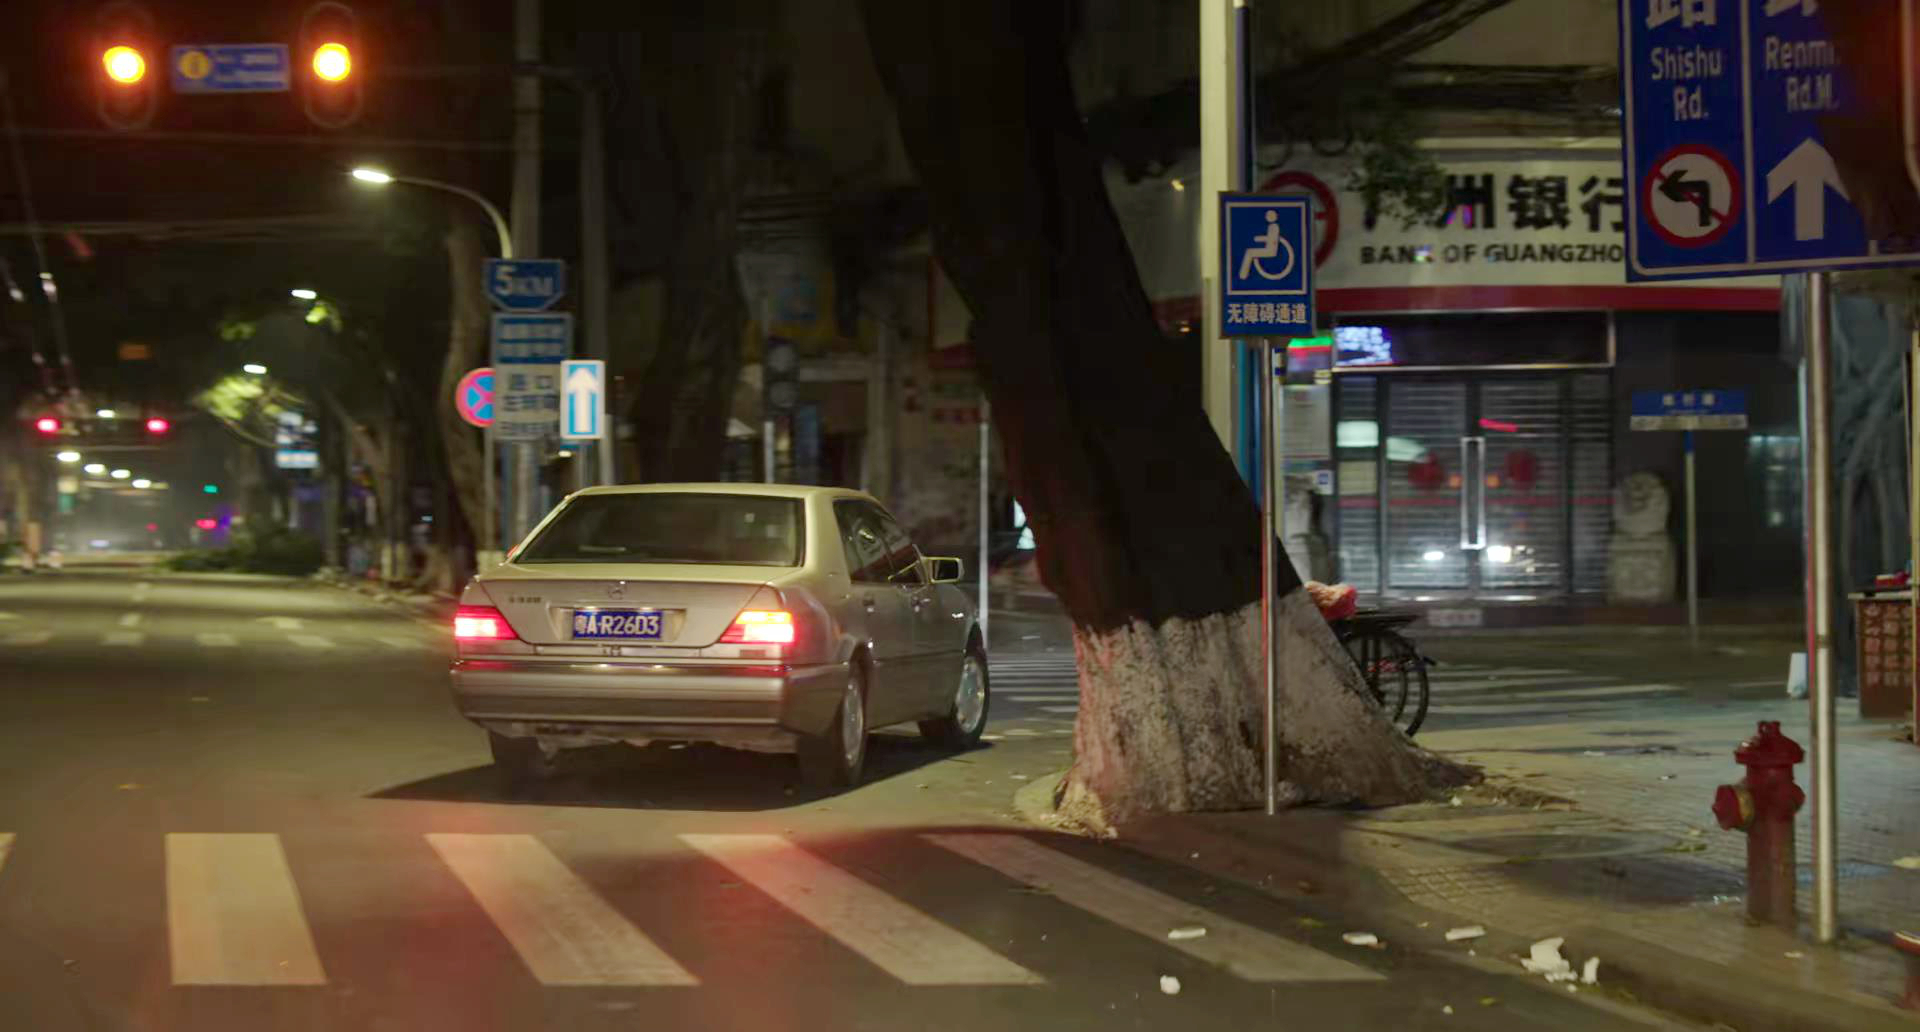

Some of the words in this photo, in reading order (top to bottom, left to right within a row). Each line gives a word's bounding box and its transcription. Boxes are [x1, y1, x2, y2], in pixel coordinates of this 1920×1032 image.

[1650, 43, 1723, 81] Shishu
[1672, 84, 1710, 121] Rd.
[1443, 245, 1477, 263] OF
[1484, 243, 1624, 263] GUANGZHO
[1227, 302, 1307, 324] 无障碍通道
